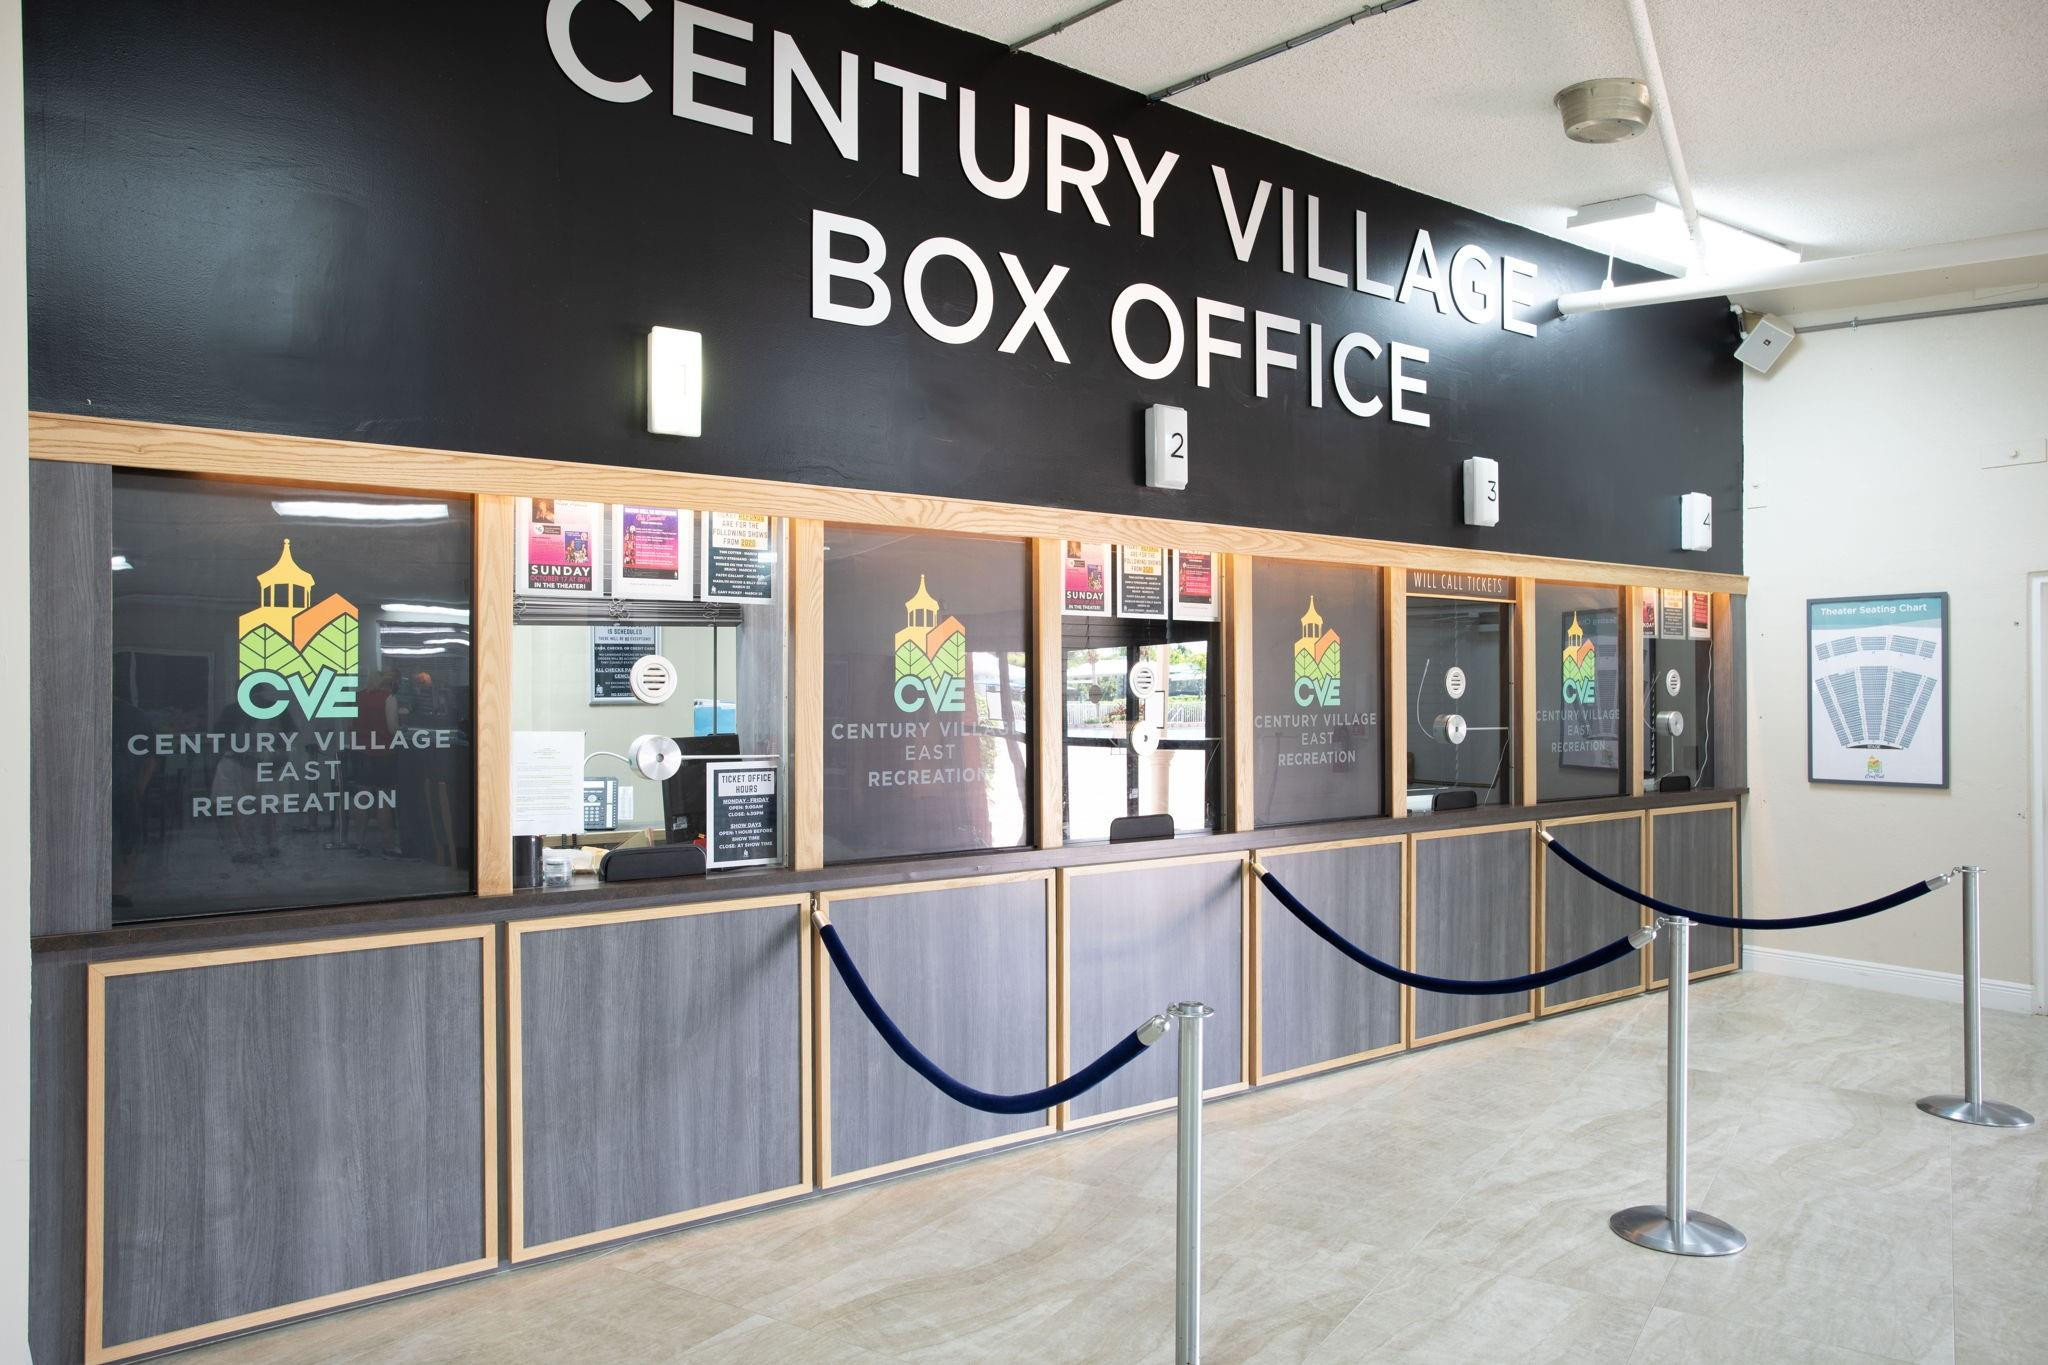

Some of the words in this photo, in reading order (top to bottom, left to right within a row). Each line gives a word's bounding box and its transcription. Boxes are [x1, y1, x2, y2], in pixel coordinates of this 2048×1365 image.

[546, 0, 1179, 238] CENTURY
[1211, 164, 1537, 337] VILLAGE
[812, 209, 1071, 364] BOX
[1111, 283, 1431, 427] OFFICE
[1171, 432, 1184, 458] 2
[1487, 480, 1497, 502] 3
[1702, 512, 1711, 529] 4
[713, 529, 746, 537] FOLLOWING
[748, 530, 768, 538] SHOWS
[532, 565, 590, 576] SUNDAY
[1414, 572, 1436, 588] WILL
[1442, 574, 1463, 590] CALL
[1467, 576, 1502, 592] TICKETS
[1067, 591, 1103, 600] SUNDAY
[1821, 608, 1856, 616] Theater
[1860, 605, 1896, 615] Seating
[1899, 603, 1927, 612] Chart
[238, 665, 358, 721] CVE
[894, 672, 966, 714] CVE
[1294, 673, 1340, 707] CVE
[1562, 676, 1596, 704] CVE
[1254, 714, 1318, 728] CENTURY
[1324, 712, 1376, 726] VILLAGE
[1536, 710, 1580, 722] CENTURY
[1582, 708, 1620, 720] VILLAGE
[832, 722, 929, 740] CENTURY
[1568, 724, 1590, 736] EAST
[128, 732, 299, 756] CENTURY
[314, 729, 451, 750] VILLAGE
[1302, 732, 1334, 746] EAST
[1552, 740, 1606, 753] RECREATION
[906, 744, 955, 760] EAST
[1278, 750, 1356, 766] RECREATION
[256, 760, 341, 782] EAST
[722, 775, 745, 783] TICKET
[748, 774, 771, 782] OFFICE
[736, 785, 758, 793] HOURS
[192, 790, 396, 817] RECREATION
